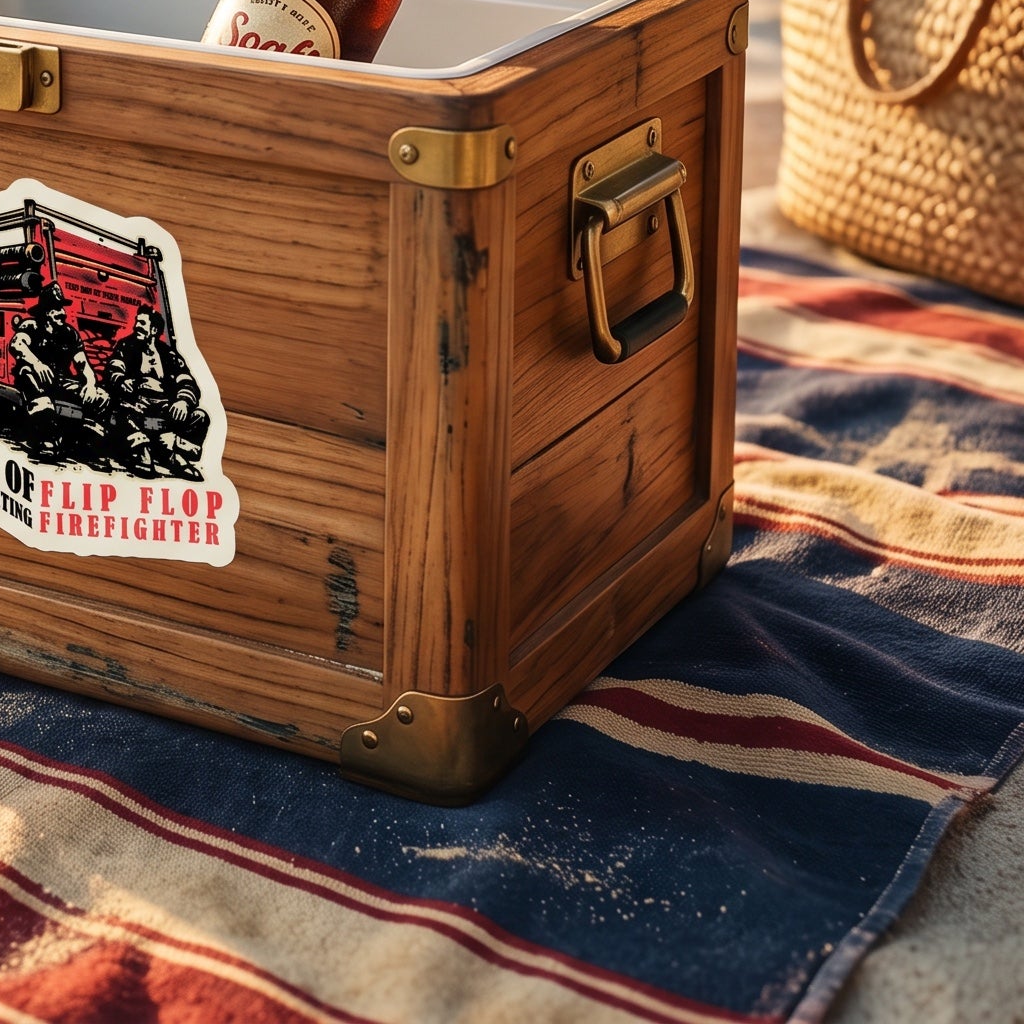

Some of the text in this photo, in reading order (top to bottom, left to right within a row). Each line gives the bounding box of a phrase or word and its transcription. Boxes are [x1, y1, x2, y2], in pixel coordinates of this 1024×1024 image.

[5, 444, 35, 503] OF
[40, 480, 223, 519] FLIP FLOP
[39, 511, 220, 545] FIREFIGHTER
